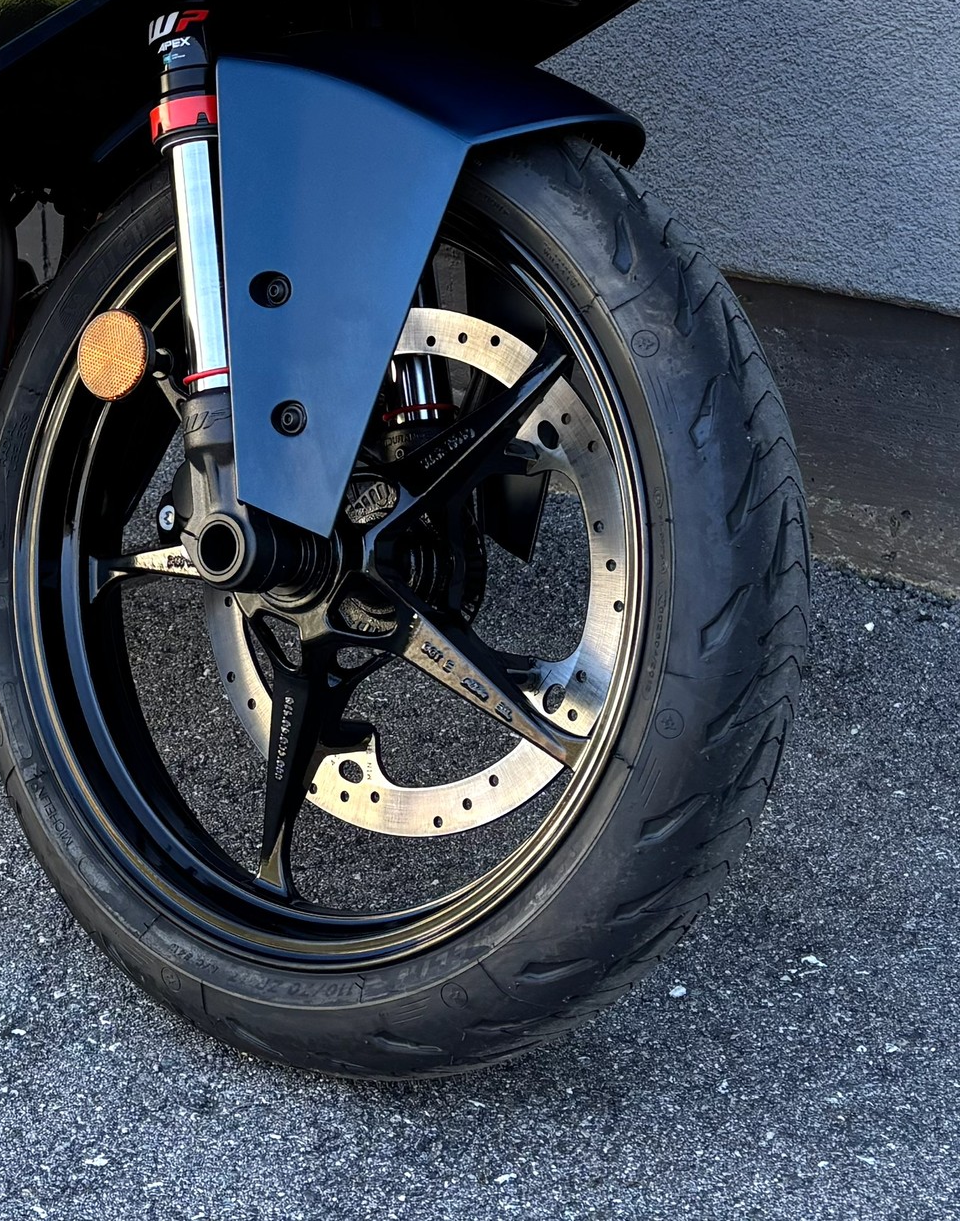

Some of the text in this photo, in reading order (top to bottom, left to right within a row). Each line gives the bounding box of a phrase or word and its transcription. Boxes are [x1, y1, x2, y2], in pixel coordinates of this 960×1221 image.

[148, 9, 209, 46] WP
[157, 36, 191, 54] APEX
[39, 786, 73, 847] MICHELIN
